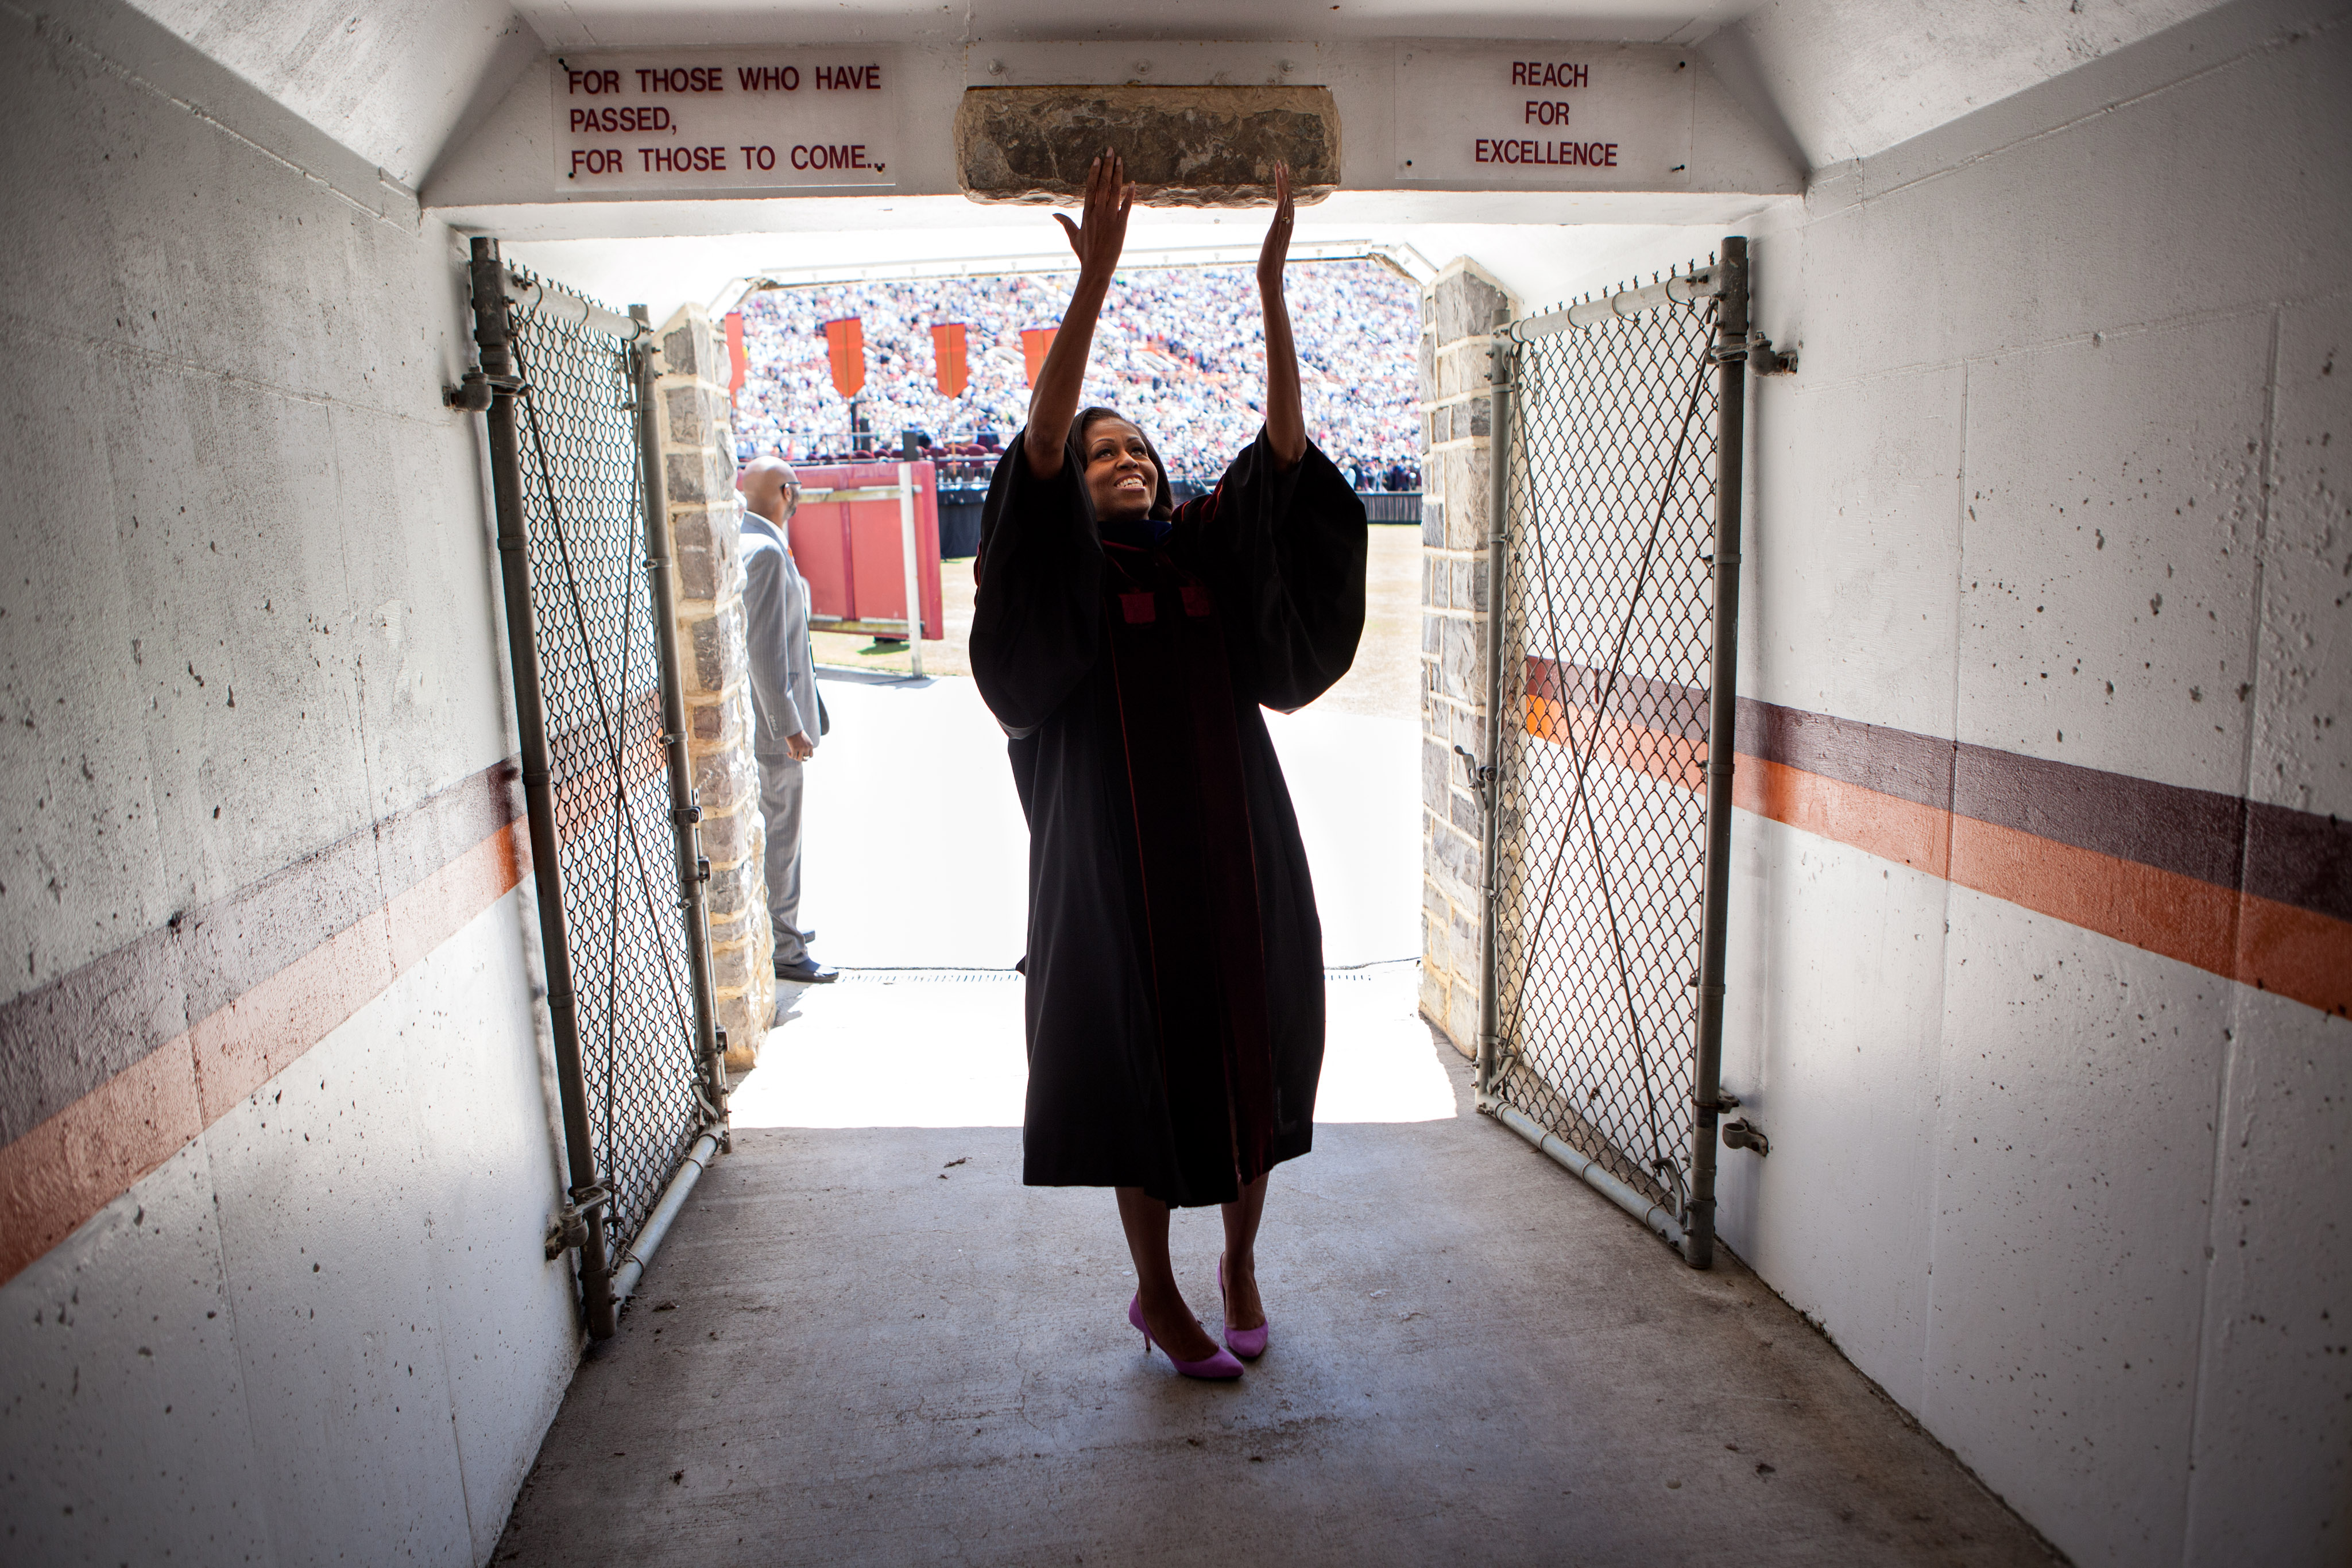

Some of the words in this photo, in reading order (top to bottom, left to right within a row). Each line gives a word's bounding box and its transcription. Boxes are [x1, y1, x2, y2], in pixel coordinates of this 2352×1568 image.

[568, 69, 620, 95] FOR
[635, 67, 724, 92] THOSE
[737, 66, 800, 90] WHO
[815, 66, 881, 90] HAVE
[1512, 61, 1588, 87] REACH
[570, 107, 677, 134] PASSED,
[1525, 101, 1570, 125] FOR
[571, 149, 623, 174] FOR
[638, 147, 726, 172] THOSE
[740, 146, 776, 170] TO
[791, 145, 885, 169] COME...
[1475, 140, 1618, 167] EXCELLENCE
